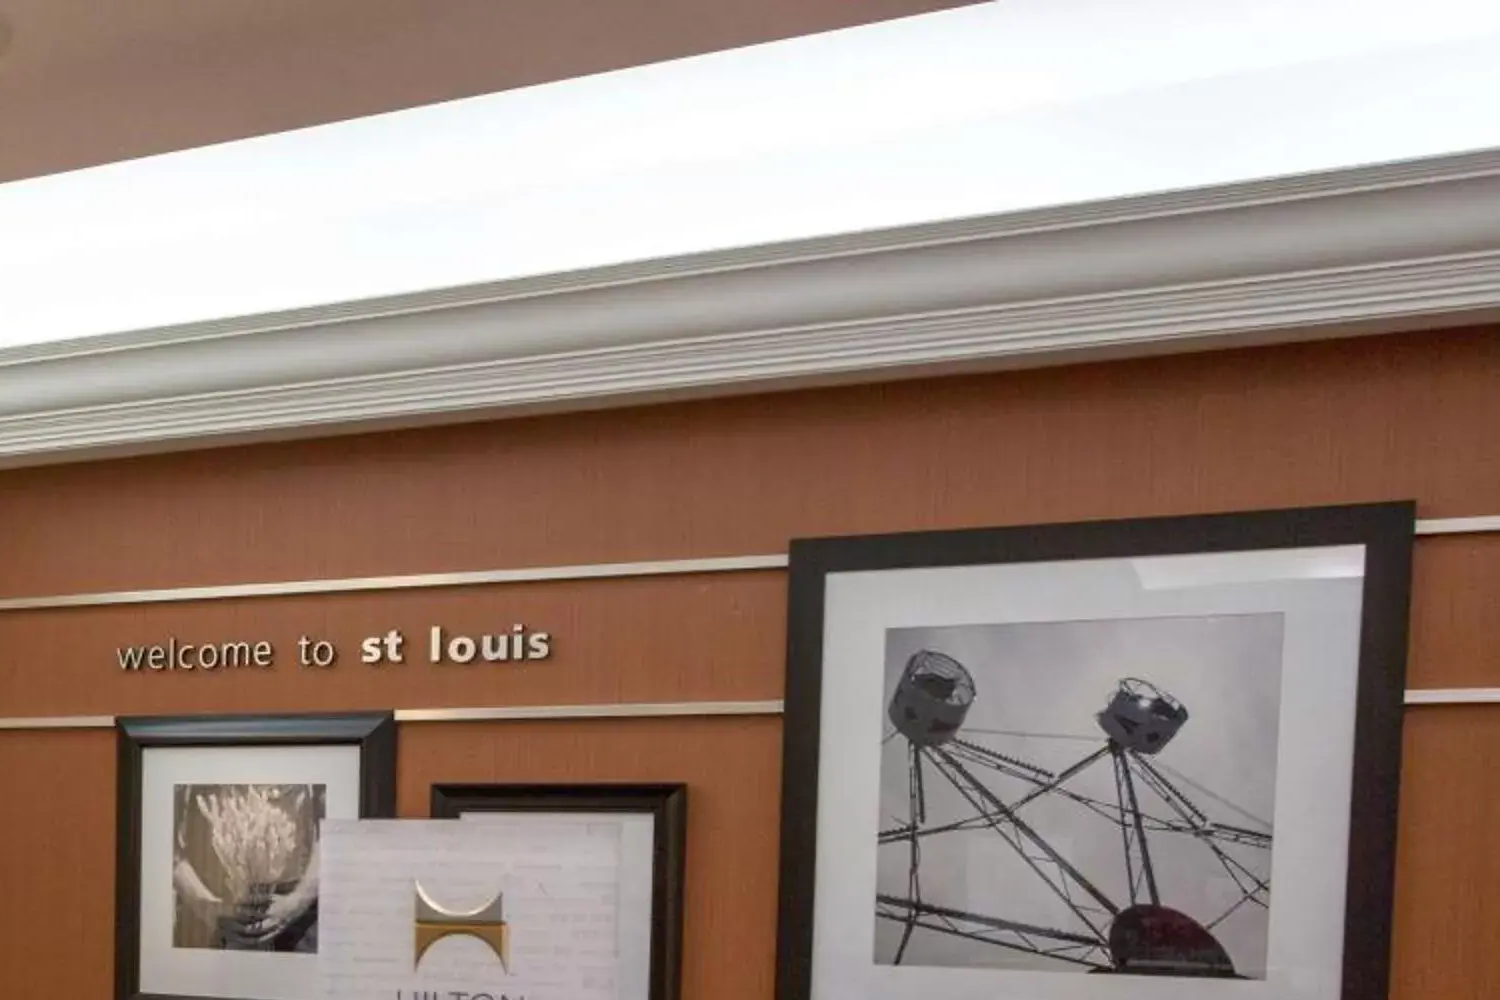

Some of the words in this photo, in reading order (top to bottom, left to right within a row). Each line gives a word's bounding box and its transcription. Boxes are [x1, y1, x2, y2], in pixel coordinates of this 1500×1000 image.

[117, 638, 272, 670] welcome
[298, 635, 335, 666] to
[361, 630, 404, 664] st
[429, 625, 551, 663] louis
